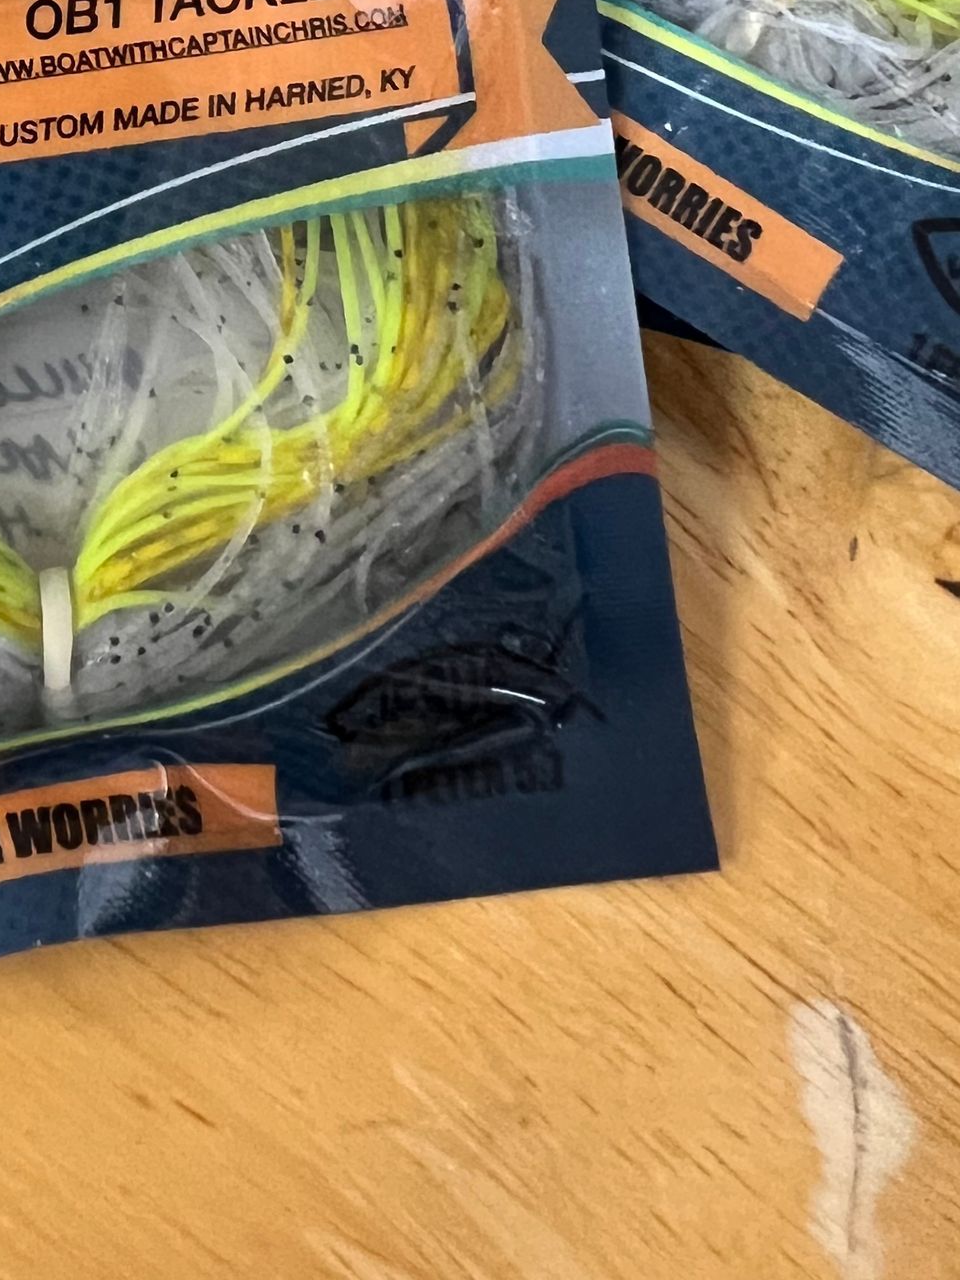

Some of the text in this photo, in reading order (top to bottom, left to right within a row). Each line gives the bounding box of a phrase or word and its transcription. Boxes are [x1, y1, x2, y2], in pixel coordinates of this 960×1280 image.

[113, 97, 199, 131] MADE
[208, 91, 236, 116] IN
[245, 74, 372, 112] HARNED,
[380, 65, 417, 92] KY
